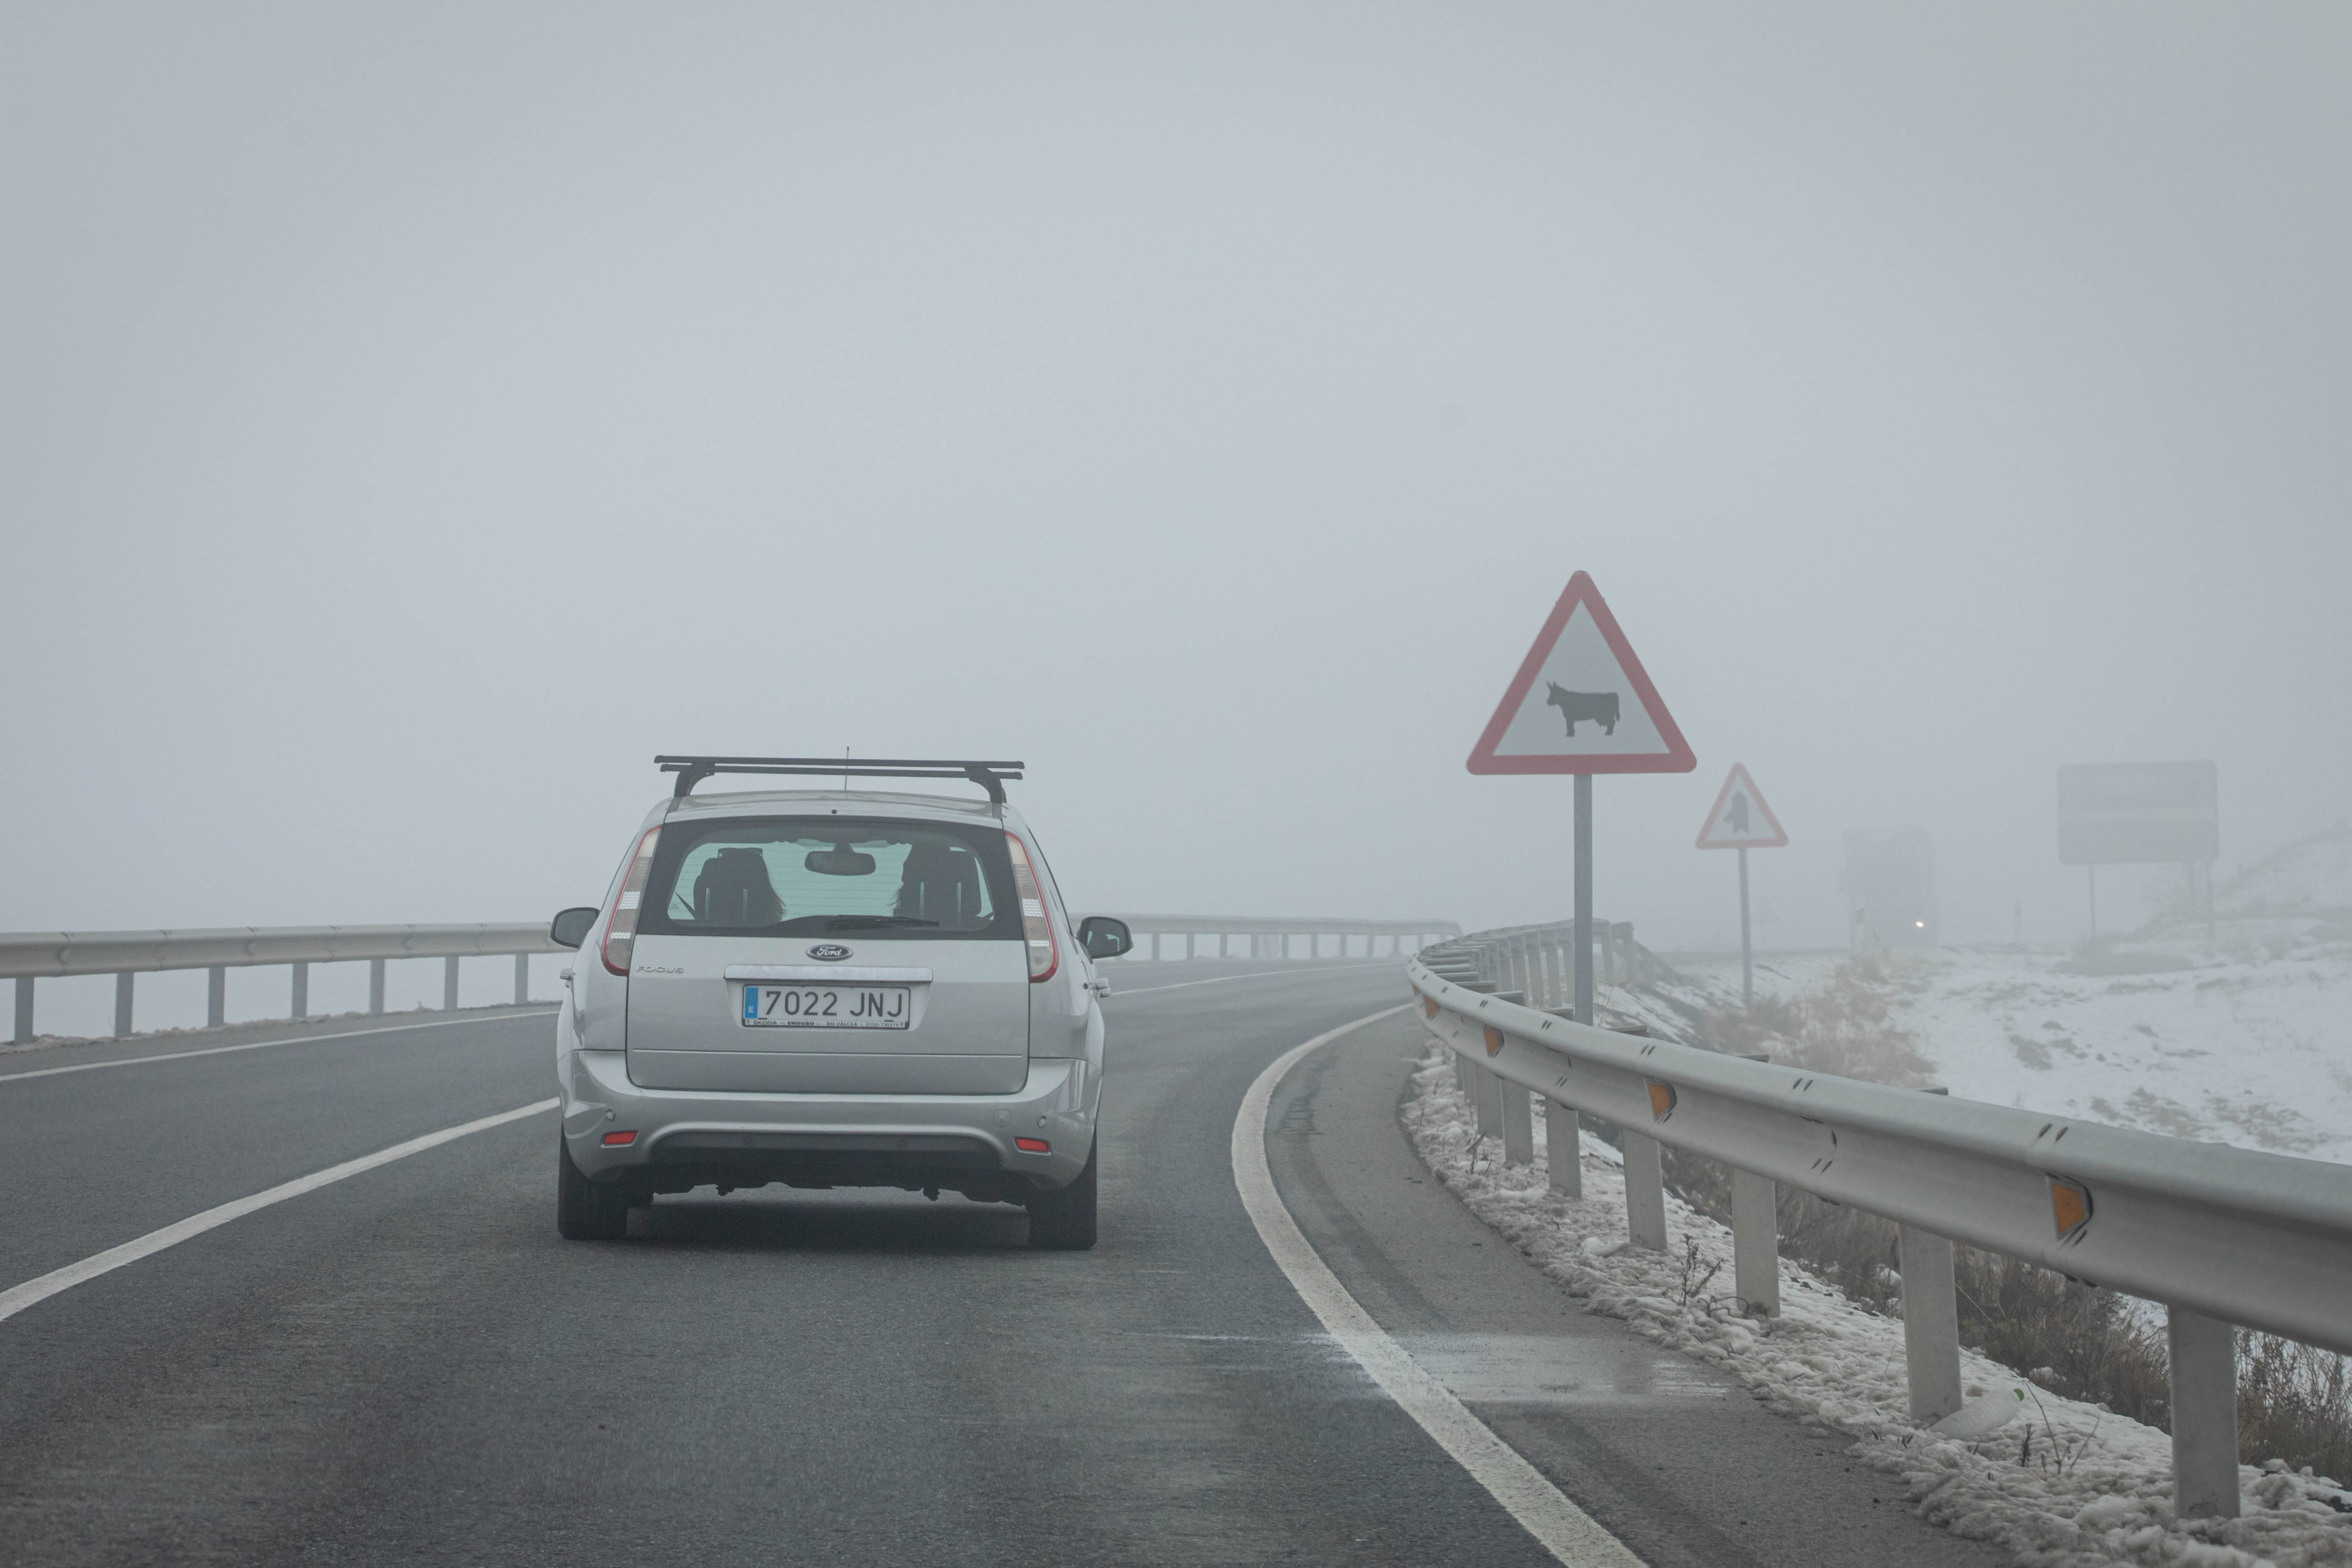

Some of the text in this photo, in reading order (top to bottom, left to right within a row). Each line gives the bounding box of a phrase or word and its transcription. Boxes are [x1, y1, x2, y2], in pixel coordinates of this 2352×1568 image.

[817, 947, 842, 956] Ford
[765, 991, 902, 1017] 7022 JNJ
